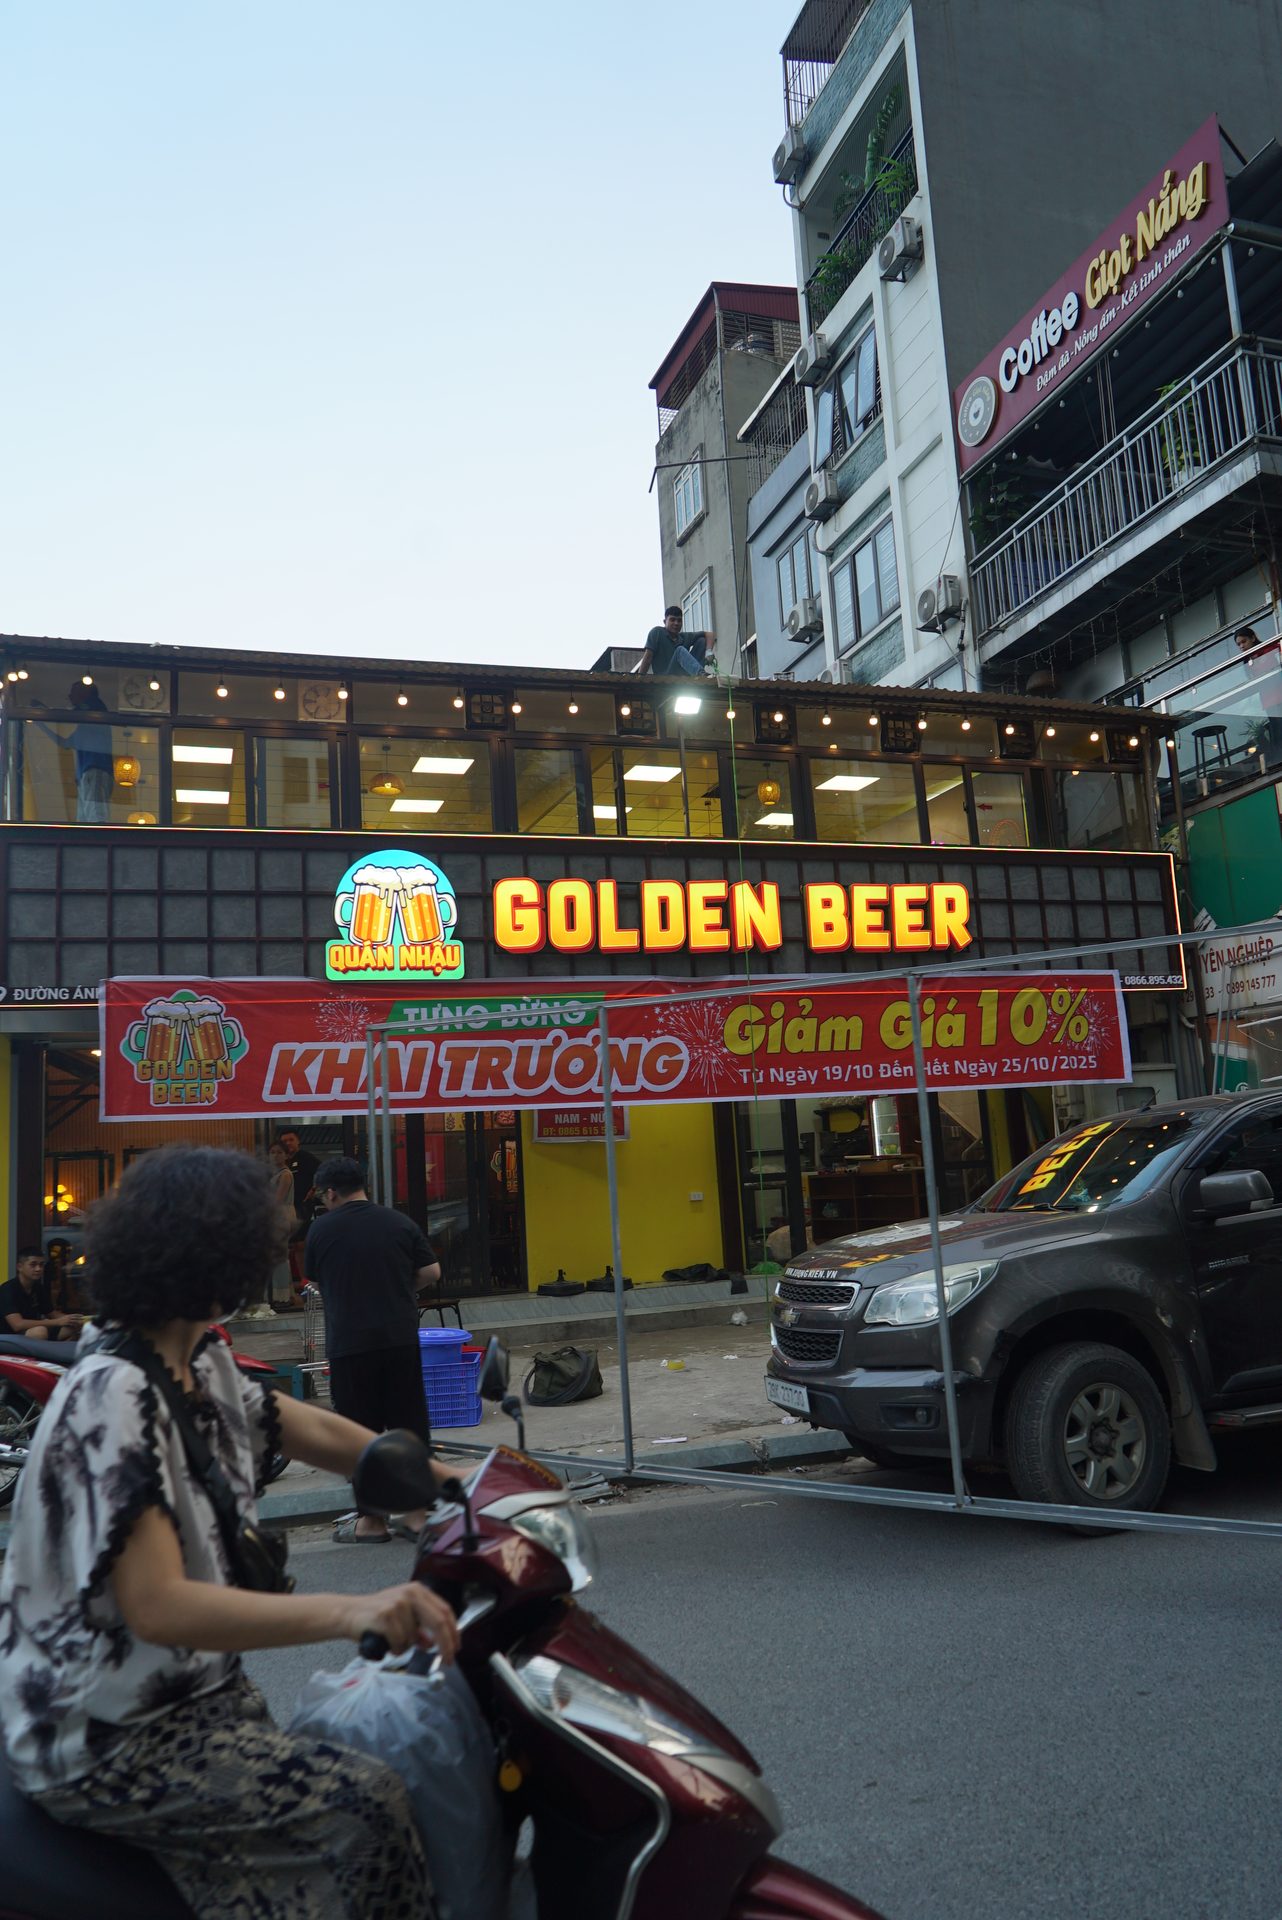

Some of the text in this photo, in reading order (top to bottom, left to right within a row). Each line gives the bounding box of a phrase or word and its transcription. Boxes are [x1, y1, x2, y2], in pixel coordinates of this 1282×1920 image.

[999, 161, 1207, 392] Coffee Giọt Nắng
[1121, 280, 1139, 310] Kết
[493, 877, 974, 954] GOLDEN BEER
[329, 939, 461, 976] QUÁN NHẬU
[12, 985, 70, 1001] ĐƯỜNG
[1124, 974, 1183, 985] 0866.895.432
[723, 986, 1089, 1055] Giảm Giá 10%
[137, 1060, 232, 1081] GOLDEN
[262, 1028, 690, 1102] KHAI TRƯƠNG
[770, 1067, 819, 1086] Ngày
[823, 1064, 873, 1083] 19/10
[879, 1060, 914, 1078] Đến
[954, 1055, 999, 1076] Ngày
[1002, 1055, 1098, 1073] 25/10/2025
[153, 1083, 215, 1104] BEER
[554, 1113, 580, 1124] NAM
